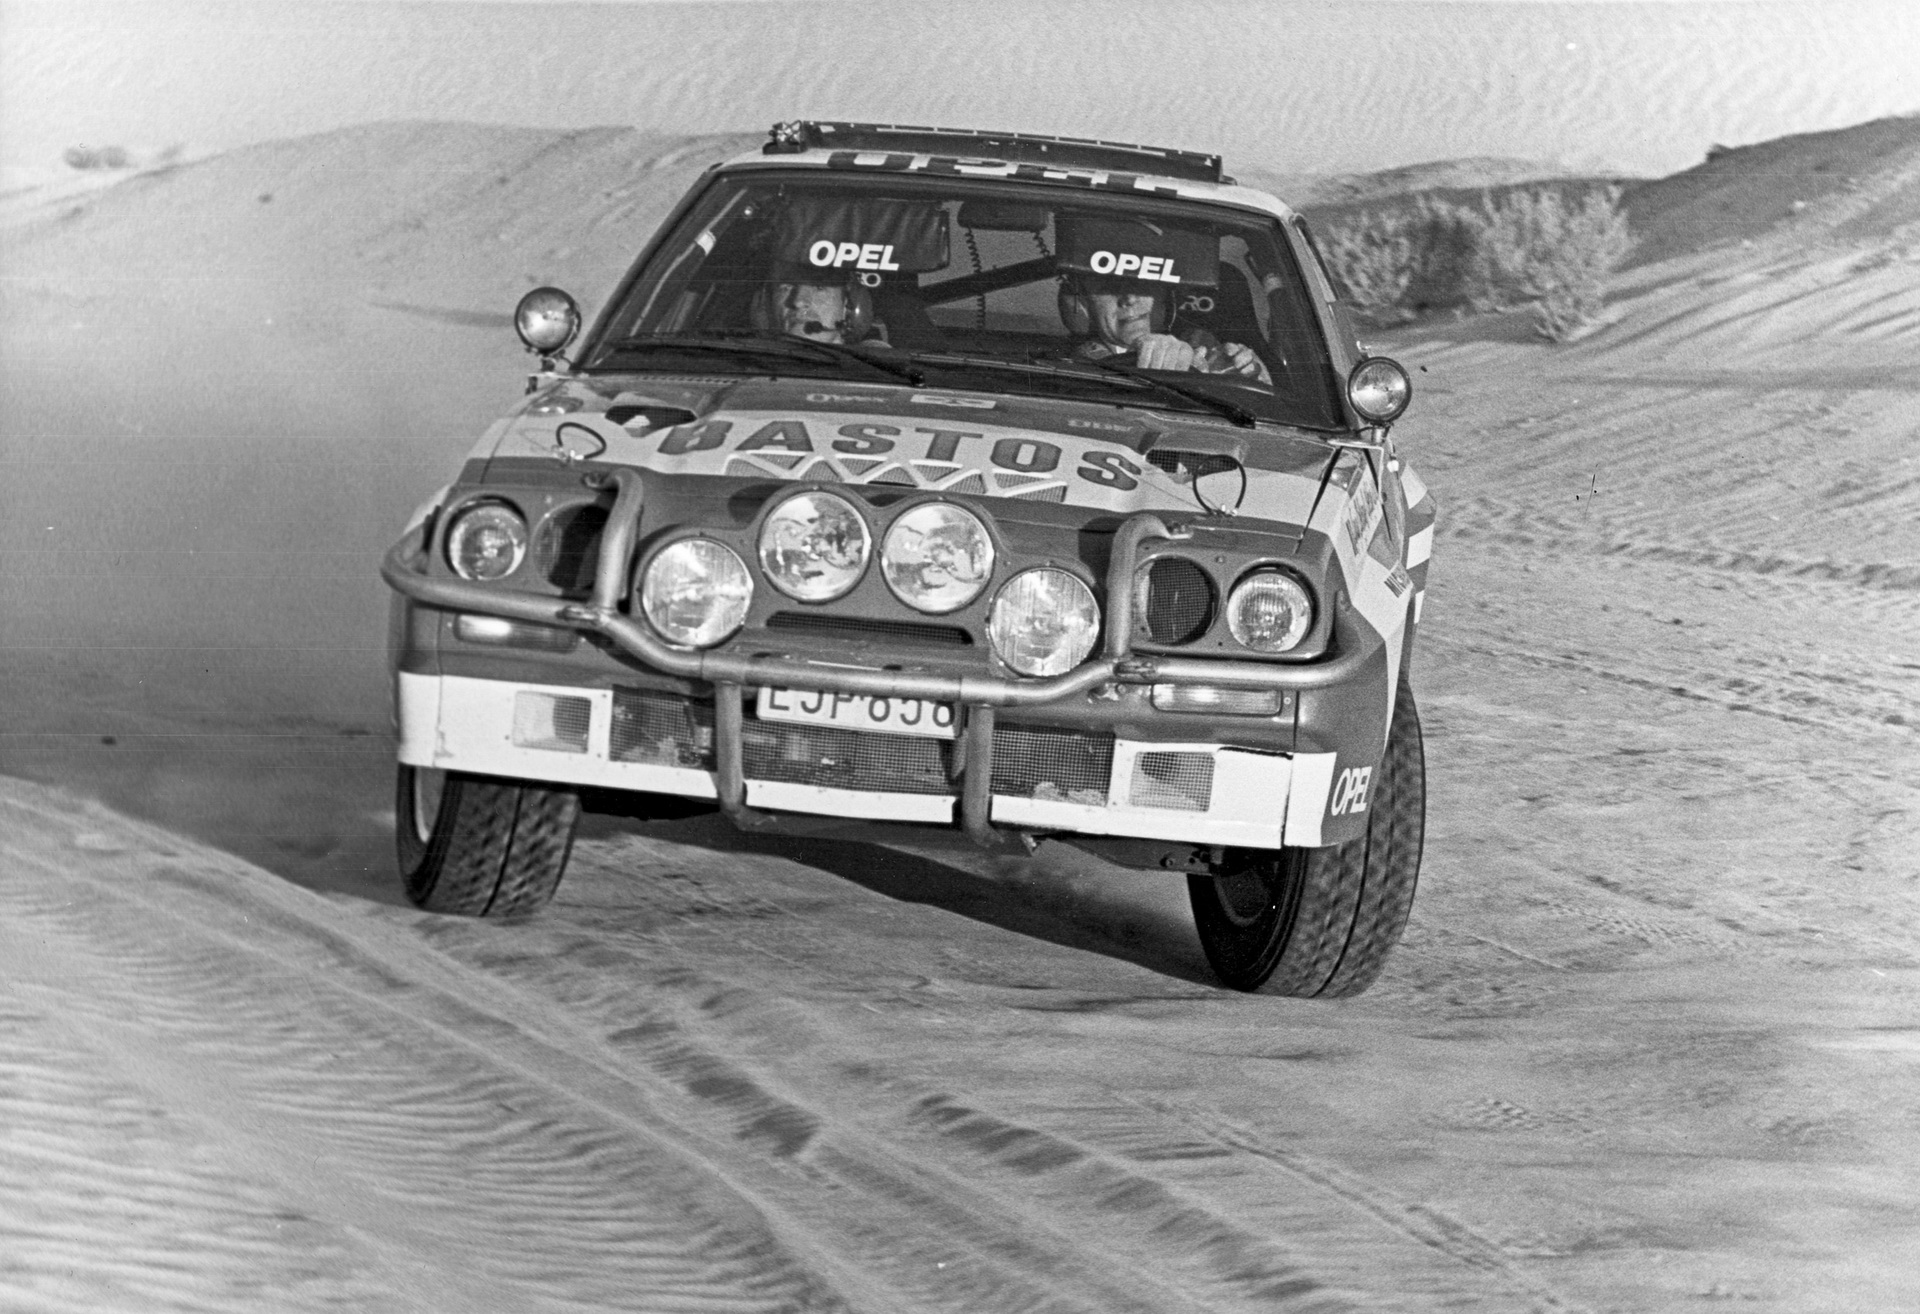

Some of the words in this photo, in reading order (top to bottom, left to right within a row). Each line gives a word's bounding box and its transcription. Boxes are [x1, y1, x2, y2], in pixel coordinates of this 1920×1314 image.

[809, 240, 900, 271] OPEL
[1090, 251, 1181, 284] OPEL
[657, 420, 1142, 491] BASTOS
[1331, 766, 1372, 816] OPEL
